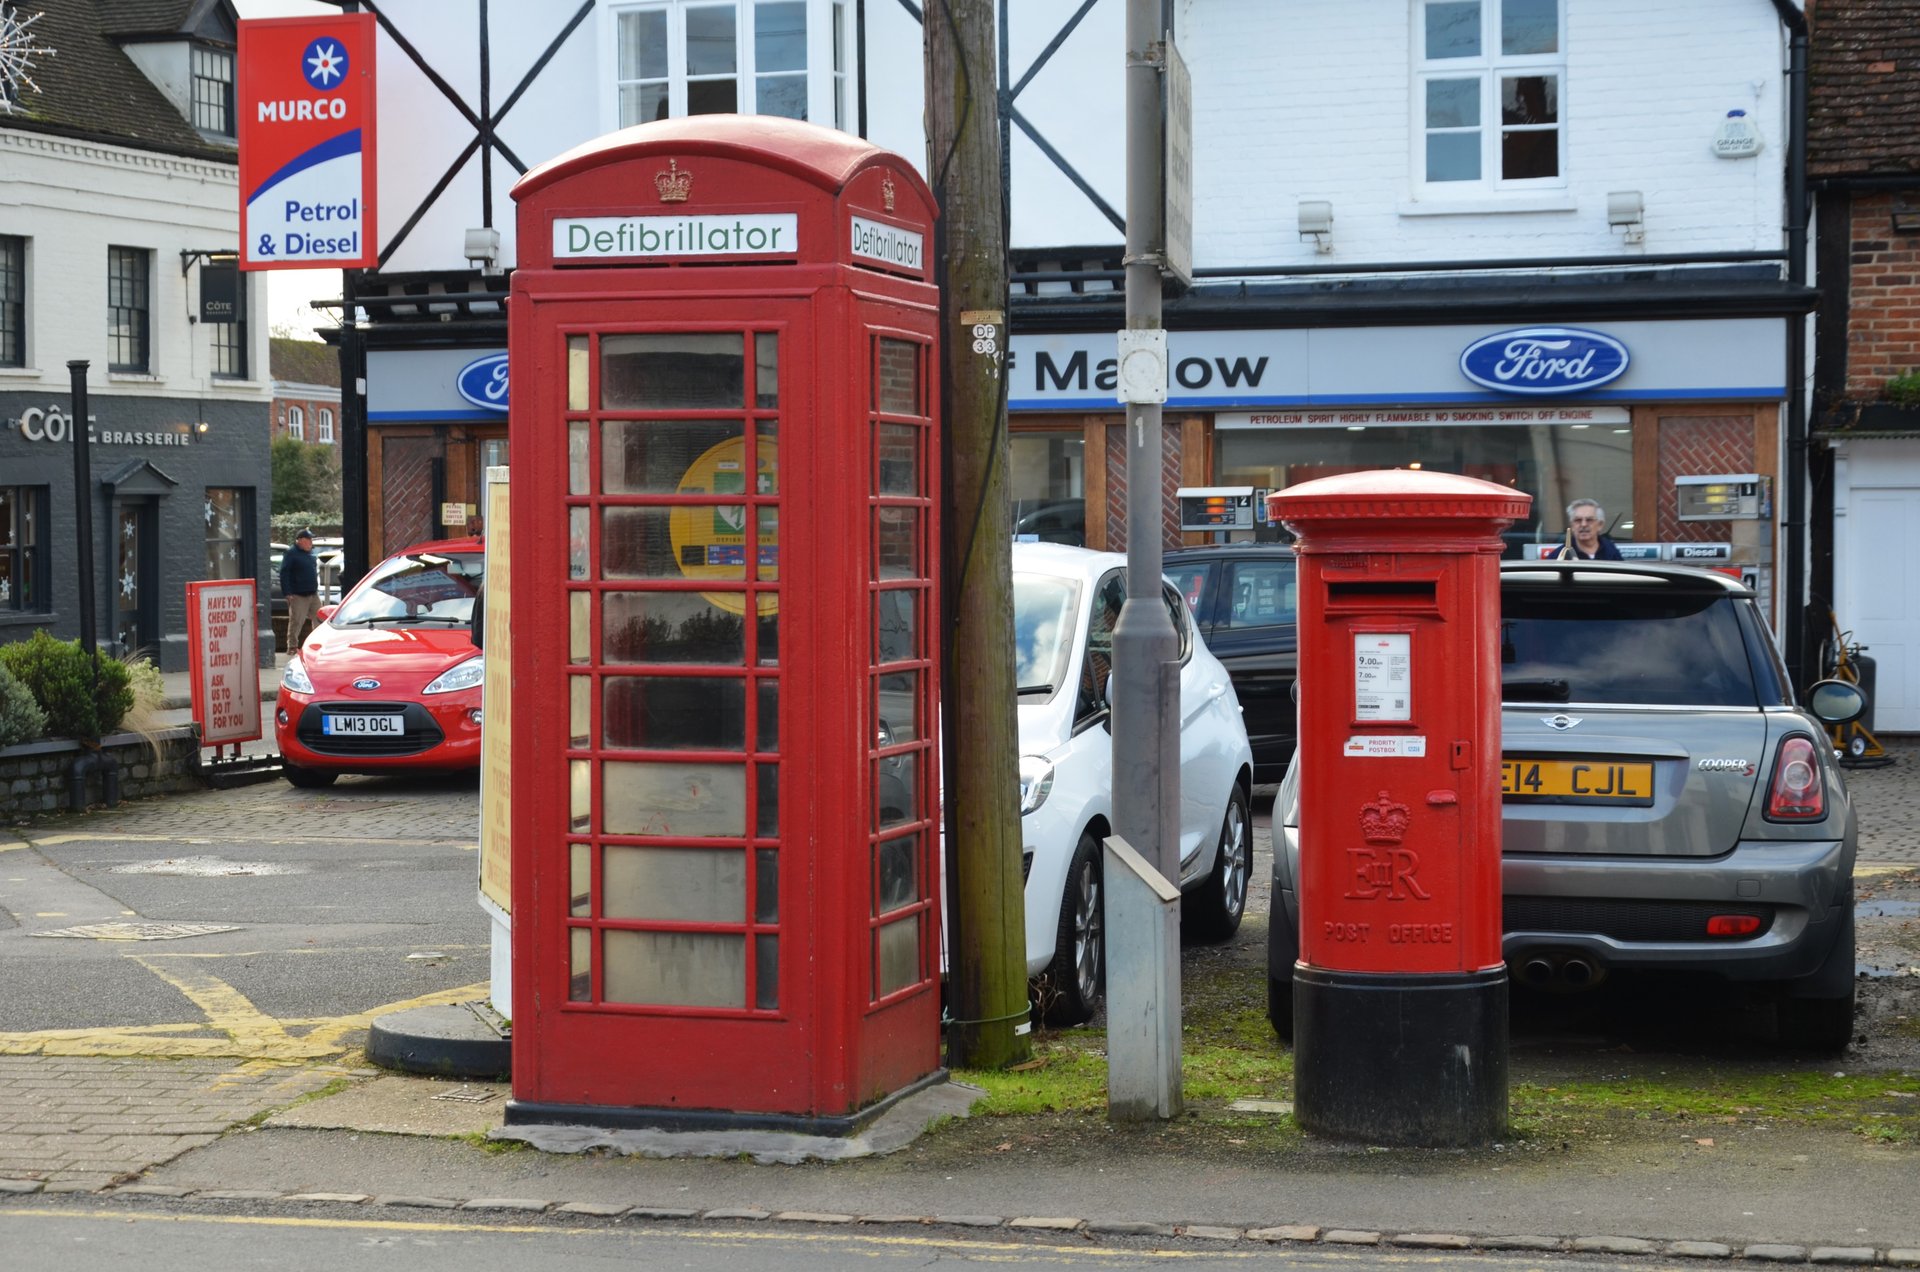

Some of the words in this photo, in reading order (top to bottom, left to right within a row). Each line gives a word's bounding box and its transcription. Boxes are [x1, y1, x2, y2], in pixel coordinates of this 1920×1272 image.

[258, 98, 346, 122] MURCO
[285, 198, 357, 222] Petrol
[258, 233, 277, 256] &
[285, 231, 357, 255] Diesel
[568, 221, 782, 253] Defibrillator
[854, 223, 918, 265] Defibrillator
[976, 326, 994, 337] DP
[976, 341, 994, 352] 33
[1494, 339, 1597, 381] Ford
[1035, 350, 1269, 391] Maow
[1250, 415, 1302, 424] PETROLEUM
[1308, 414, 1335, 424] SPIRIT
[1340, 413, 1371, 423] HIGHLY
[1376, 412, 1430, 422] FLAMMABLE
[1435, 412, 1448, 422] NO
[1452, 412, 1494, 421] SMOKING
[1499, 411, 1533, 421] SWITCH
[1537, 411, 1555, 420] OFF
[1559, 410, 1593, 420] ENGINE
[102, 431, 189, 445] BRASSERIE
[1240, 496, 1248, 507] 2
[1683, 548, 1718, 557] Diesel
[208, 597, 226, 610] HAVE
[227, 596, 242, 609] YOU
[208, 611, 237, 624] CHECKED
[208, 626, 228, 638] YOUR
[209, 641, 220, 653] OIL
[210, 653, 232, 668] LATELY
[211, 675, 224, 687] ASK
[212, 688, 221, 700] US
[221, 688, 230, 699] TO
[213, 703, 223, 715] DO
[224, 702, 231, 713] IT
[213, 717, 227, 729] FOR
[229, 714, 243, 727] YOU
[335, 717, 366, 732] LM13
[370, 717, 398, 732] OGL
[1698, 759, 1747, 773] COOPER
[1744, 764, 1755, 776] S
[1502, 763, 1543, 792] E14
[1572, 765, 1637, 795] CJL
[1324, 921, 1370, 943] POST
[1389, 923, 1453, 944] OFFICE
